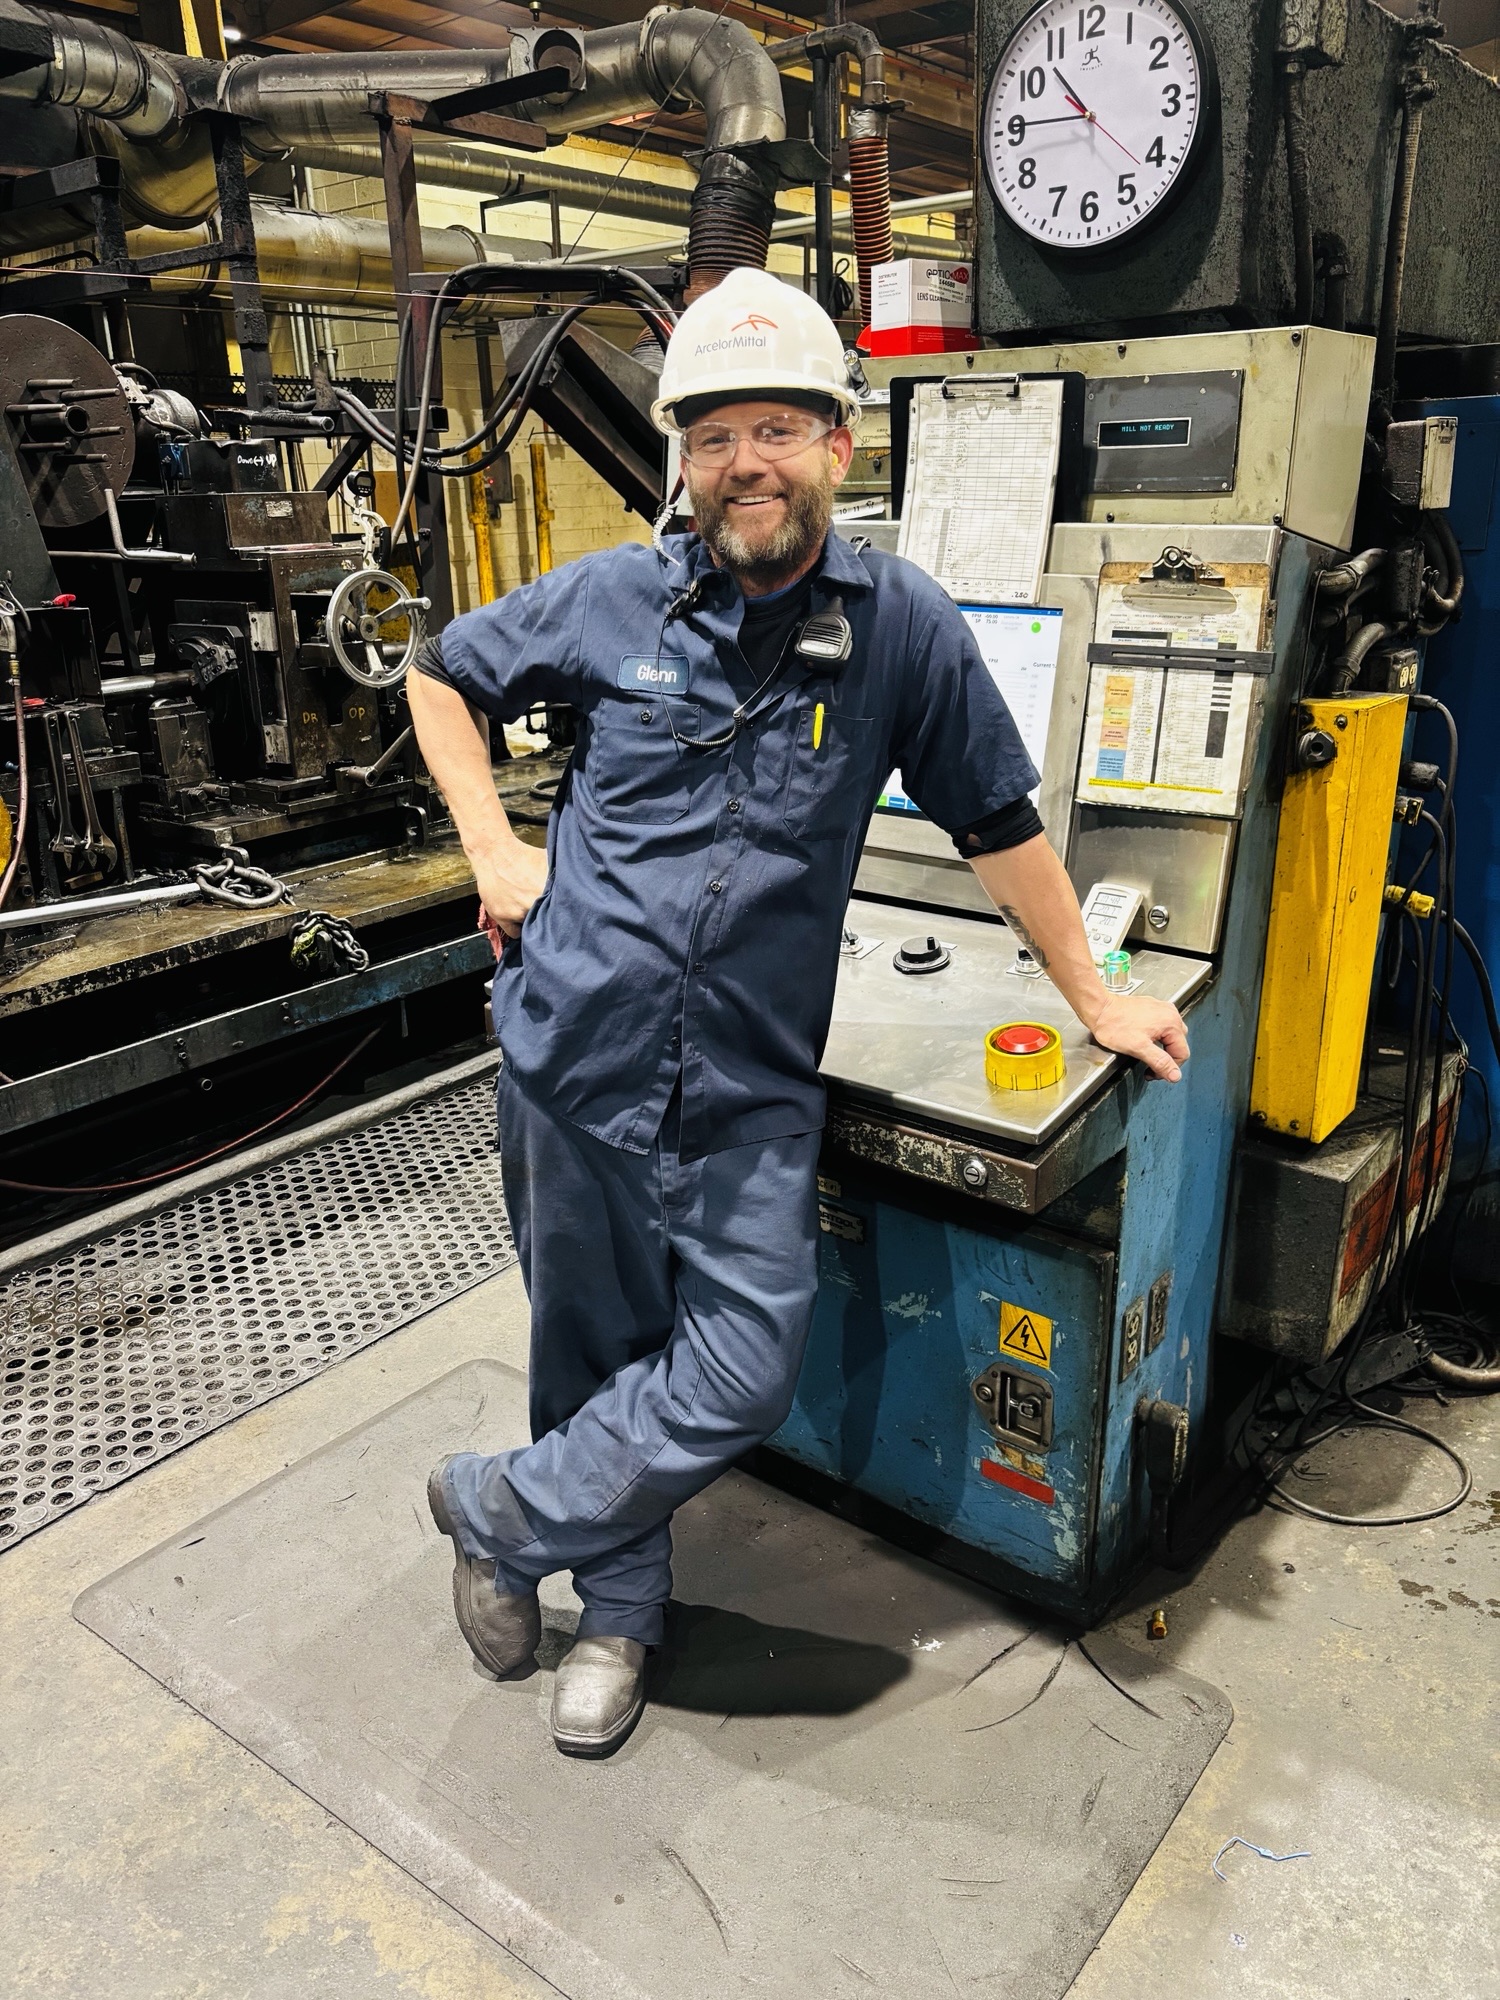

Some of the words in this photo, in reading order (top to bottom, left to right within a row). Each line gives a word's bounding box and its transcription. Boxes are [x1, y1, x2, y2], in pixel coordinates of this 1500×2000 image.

[1078, 4, 1106, 42] 12
[1126, 12, 1133, 45] 1
[1047, 27, 1065, 62] 11
[1148, 35, 1170, 71] 2
[1020, 66, 1046, 102] 10
[1161, 83, 1181, 118] 3
[1007, 114, 1026, 147] 9
[1145, 136, 1166, 168] 4
[1018, 157, 1037, 190] 8
[1117, 172, 1137, 206] 5
[1048, 185, 1068, 218] 7
[1080, 191, 1099, 223] 6
[917, 292, 929, 301] LENS
[694, 335, 766, 357] ArcelorMittal
[1140, 424, 1151, 432] NOT
[1154, 423, 1175, 431] READY
[636, 664, 677, 683] Glenn
[302, 711, 319, 724] DR
[349, 707, 366, 720] OP
